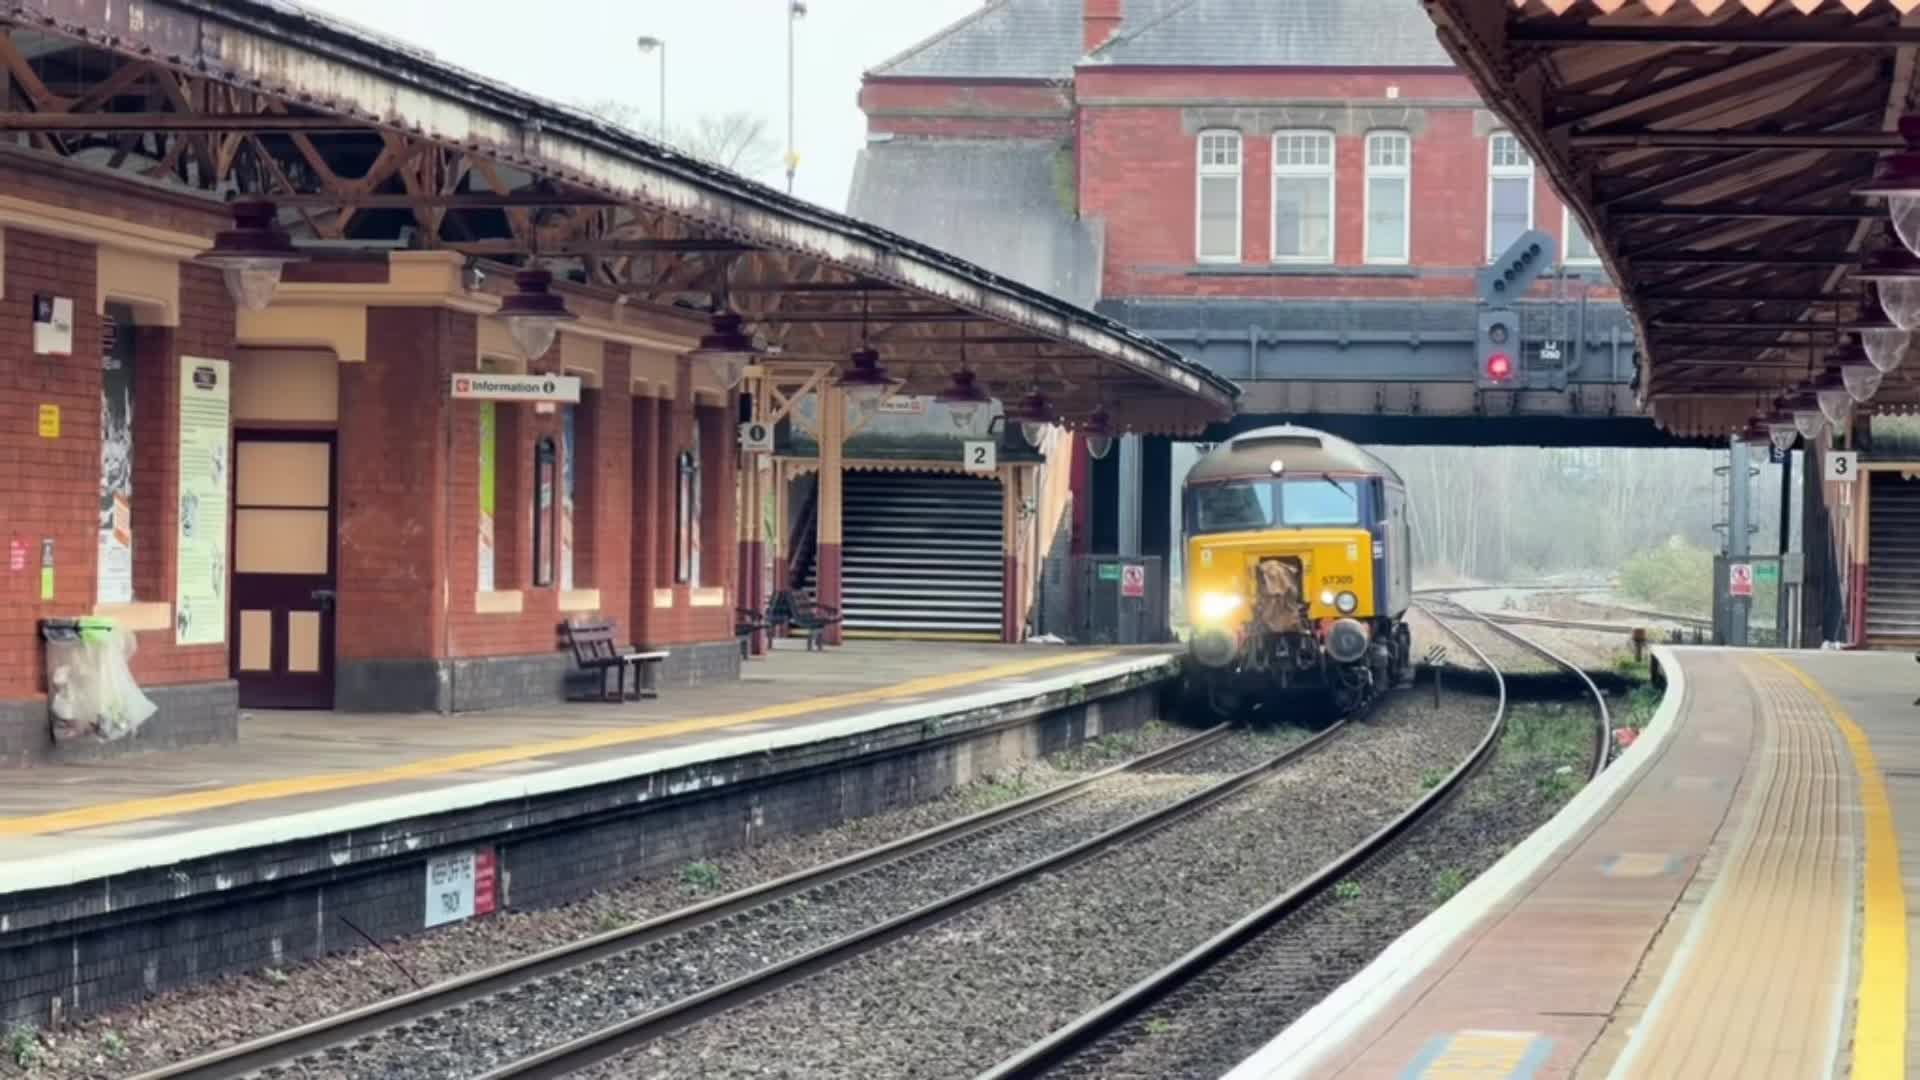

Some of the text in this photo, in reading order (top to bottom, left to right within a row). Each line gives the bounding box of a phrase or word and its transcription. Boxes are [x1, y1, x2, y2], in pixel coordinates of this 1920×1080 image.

[472, 381, 540, 392] Information
[974, 446, 985, 464] 2
[1835, 457, 1847, 475] 3
